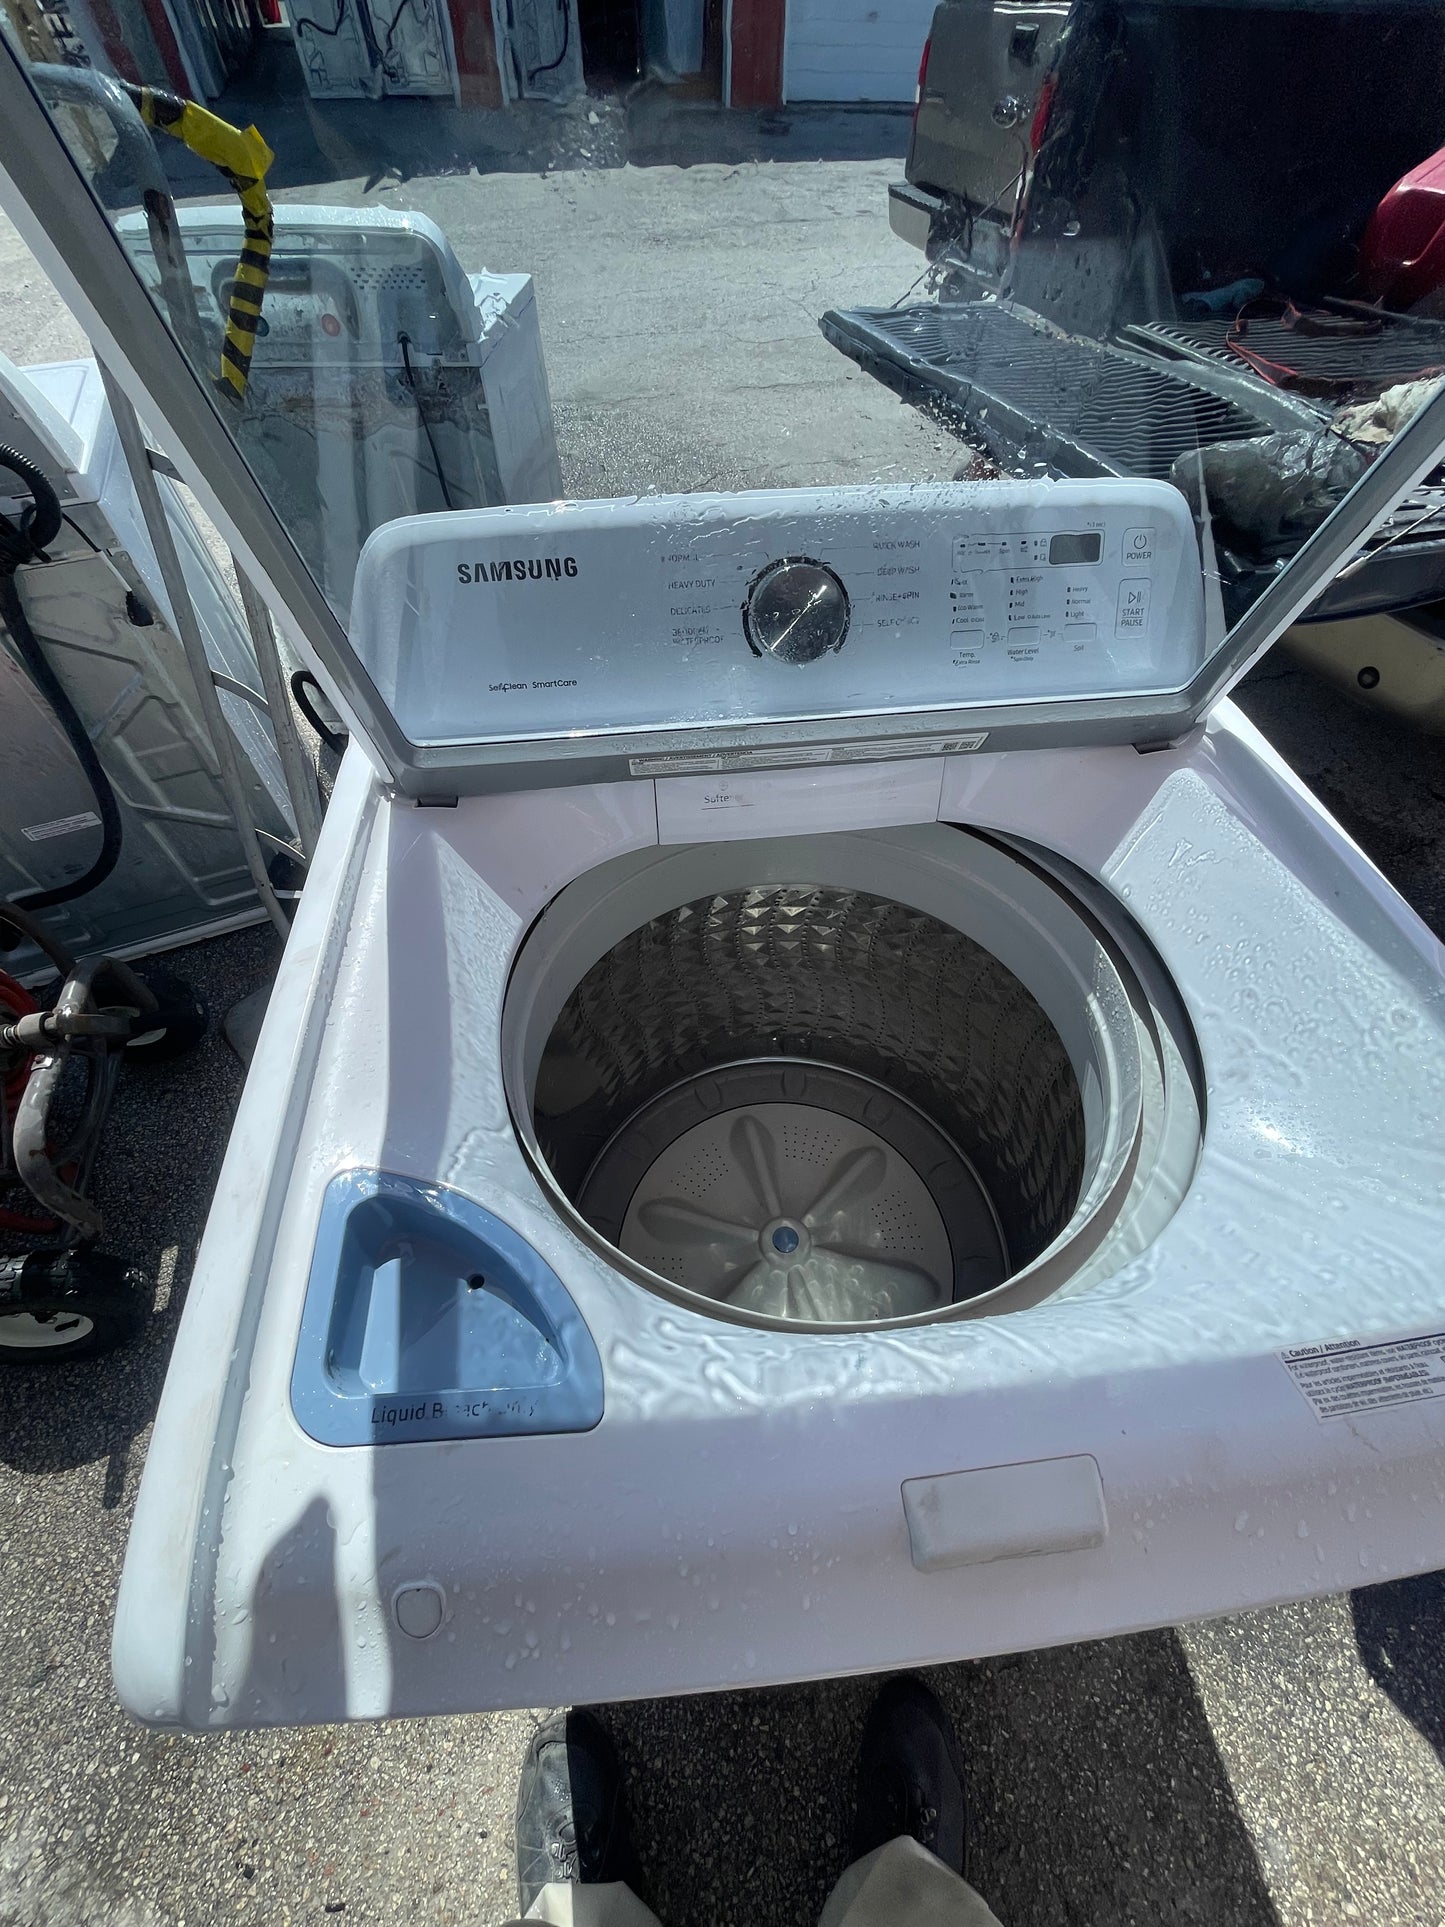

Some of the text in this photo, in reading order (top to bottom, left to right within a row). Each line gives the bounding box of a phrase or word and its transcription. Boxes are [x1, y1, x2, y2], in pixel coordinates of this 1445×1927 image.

[1126, 551, 1152, 560] POWER
[457, 556, 578, 584] SAMSUNG
[668, 579, 715, 590] HEAVY DUTY
[1122, 607, 1145, 617] START
[1120, 618, 1143, 628] PAUSE
[532, 679, 578, 689] SmartCare
[1289, 1346, 1319, 1358] Caution
[1324, 1339, 1361, 1351] Attention
[371, 1402, 426, 1426] Liquid
